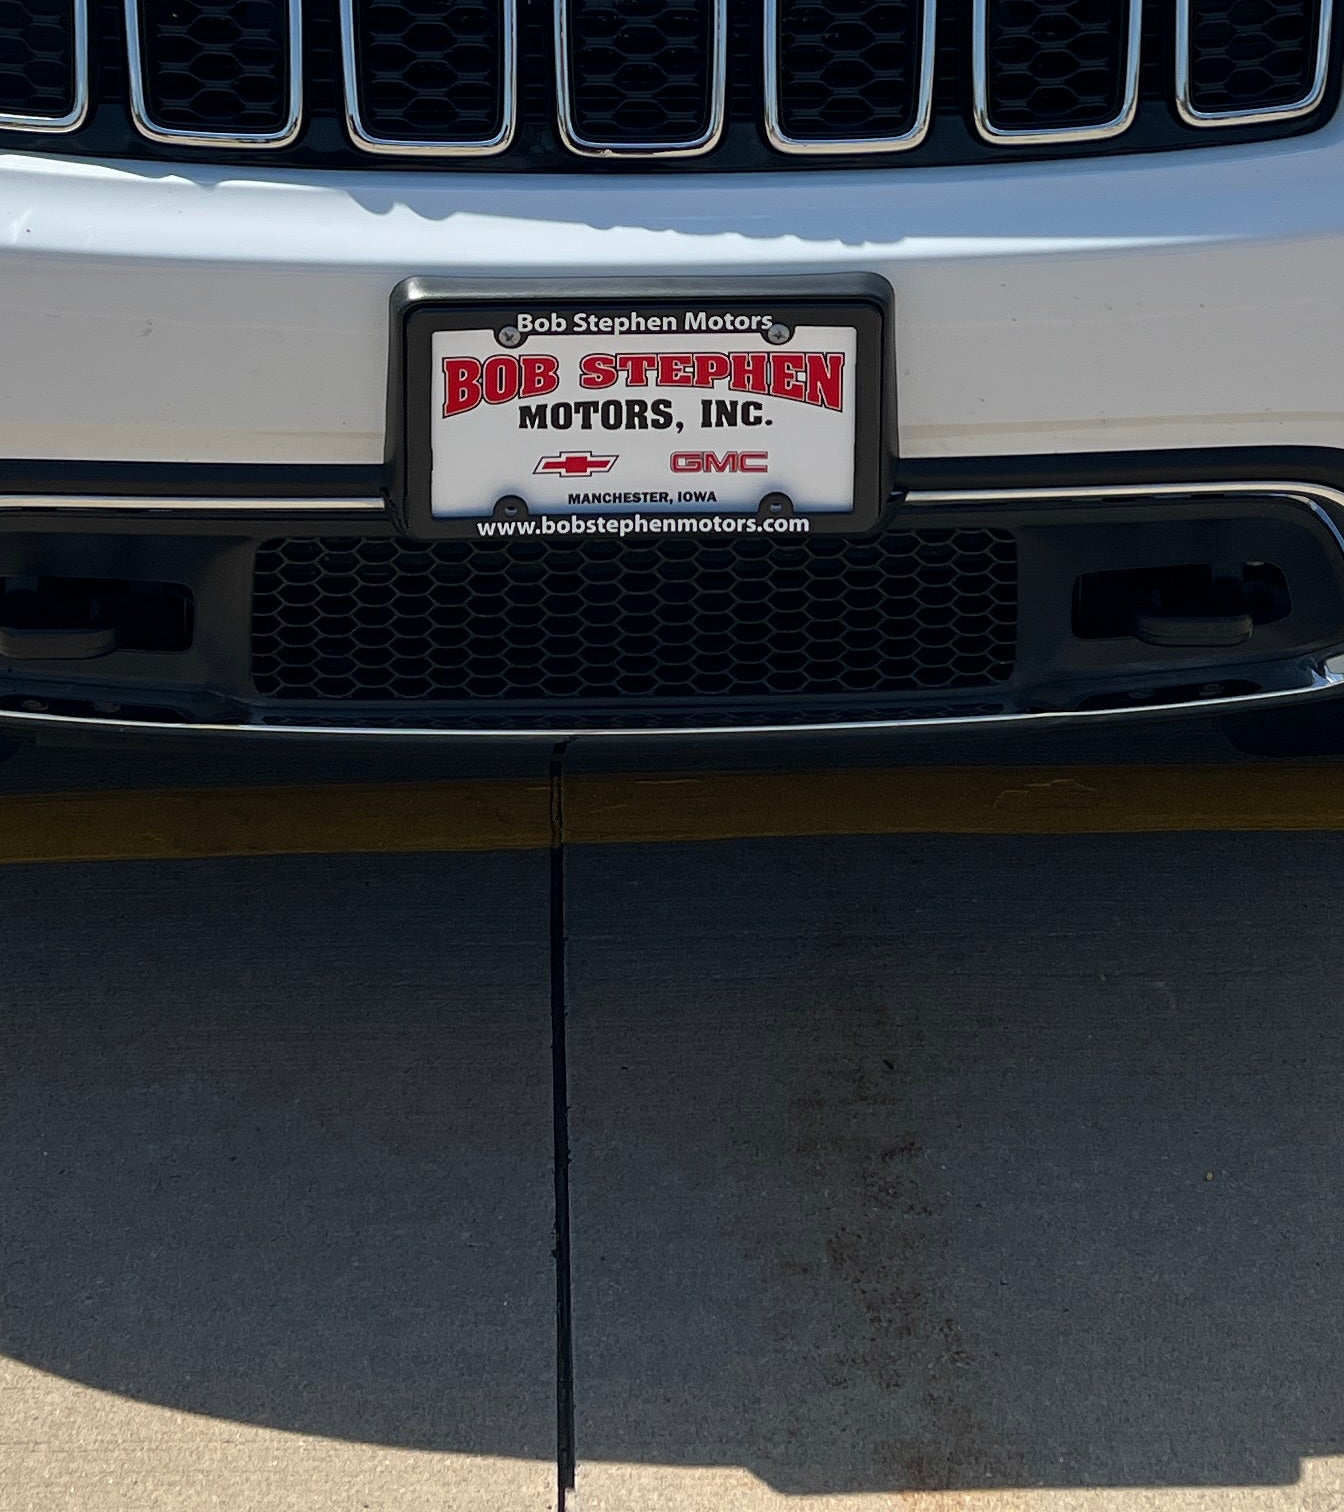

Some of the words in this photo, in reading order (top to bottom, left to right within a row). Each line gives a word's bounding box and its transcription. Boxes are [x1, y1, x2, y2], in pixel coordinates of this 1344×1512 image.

[517, 312, 567, 333] Bob
[573, 311, 676, 337] Stephen
[684, 312, 772, 331] Motors
[442, 354, 560, 418] BOB
[579, 351, 845, 413] STEPHEN
[518, 399, 684, 434] MOTORS,
[701, 399, 773, 428] INC.
[670, 451, 768, 473] GMC
[568, 492, 673, 505] MANCHESTER,
[677, 491, 717, 503] IOWA
[477, 514, 810, 537] www.bobstephenmotors.com
